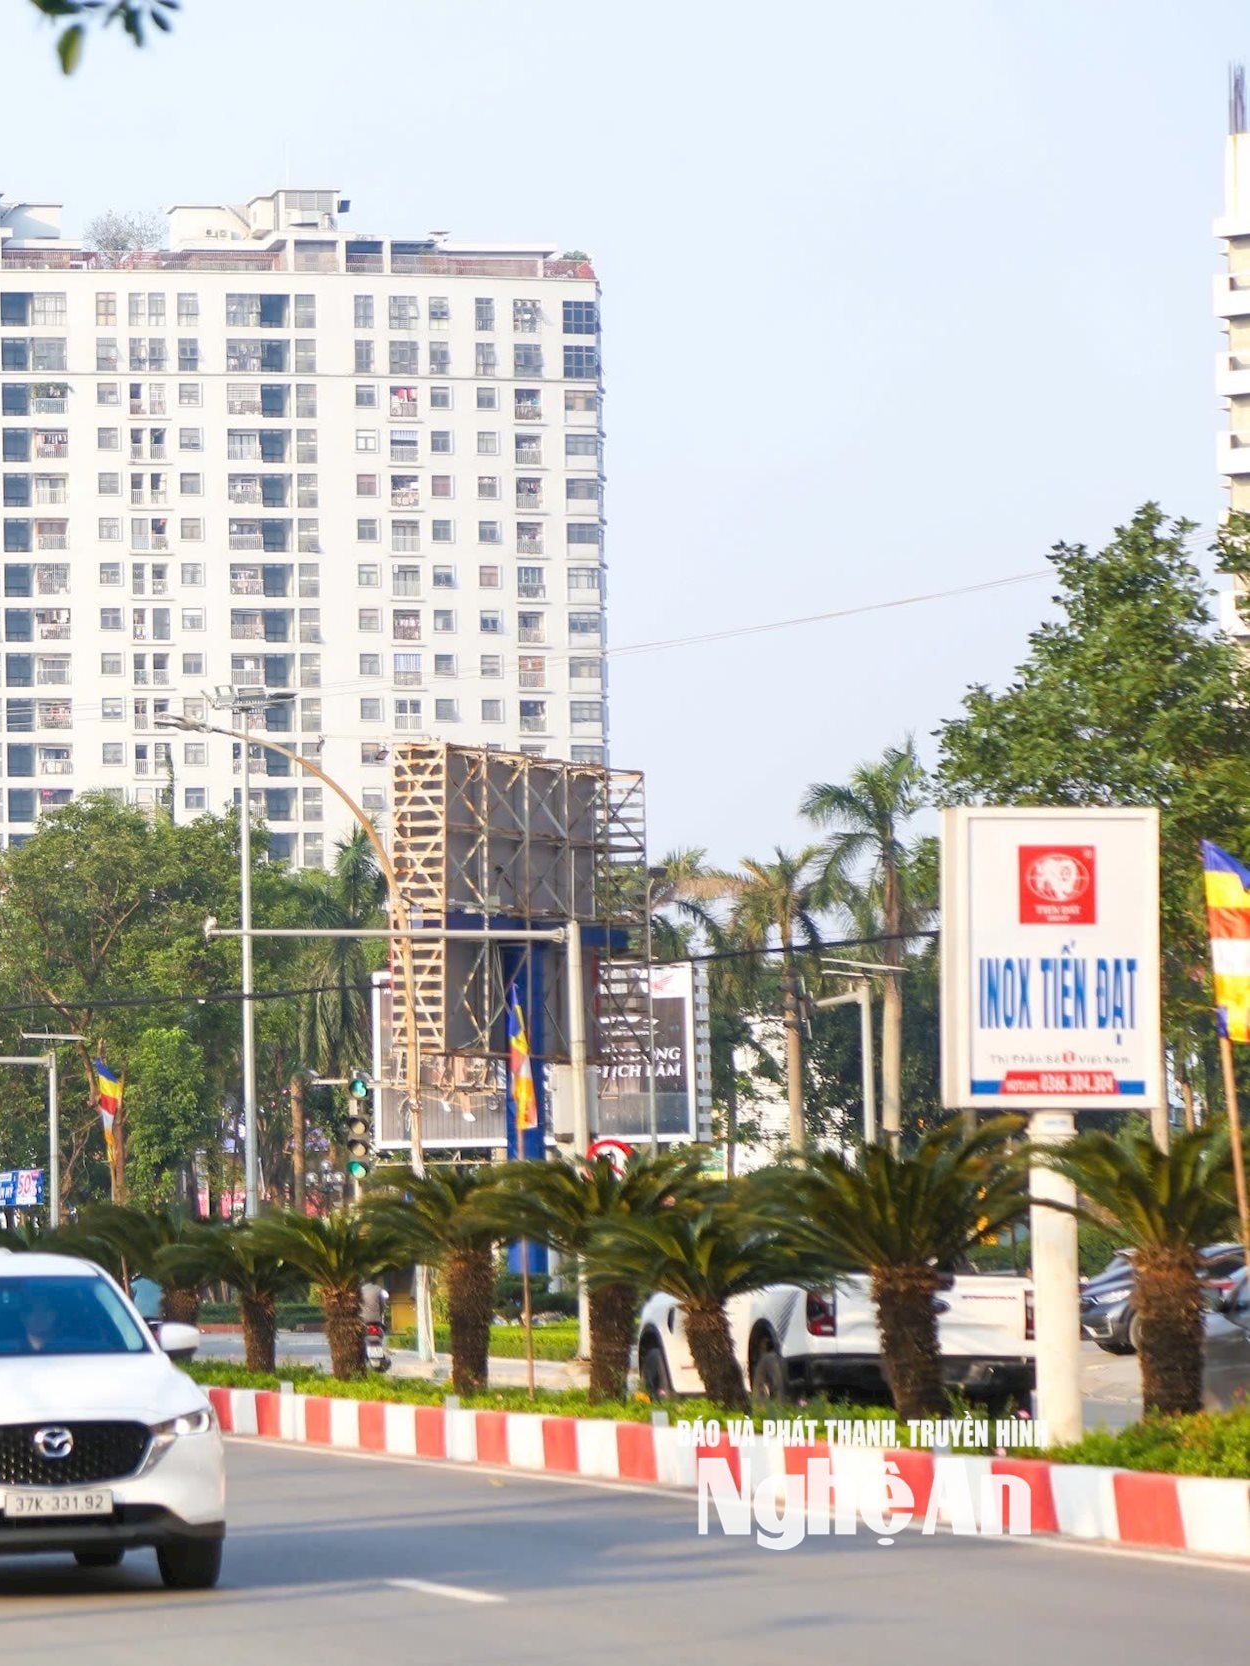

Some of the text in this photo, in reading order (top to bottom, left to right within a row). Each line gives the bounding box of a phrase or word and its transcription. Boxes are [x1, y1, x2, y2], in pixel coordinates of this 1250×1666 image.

[979, 939, 1137, 1046] INOX TIẾN ĐẠT
